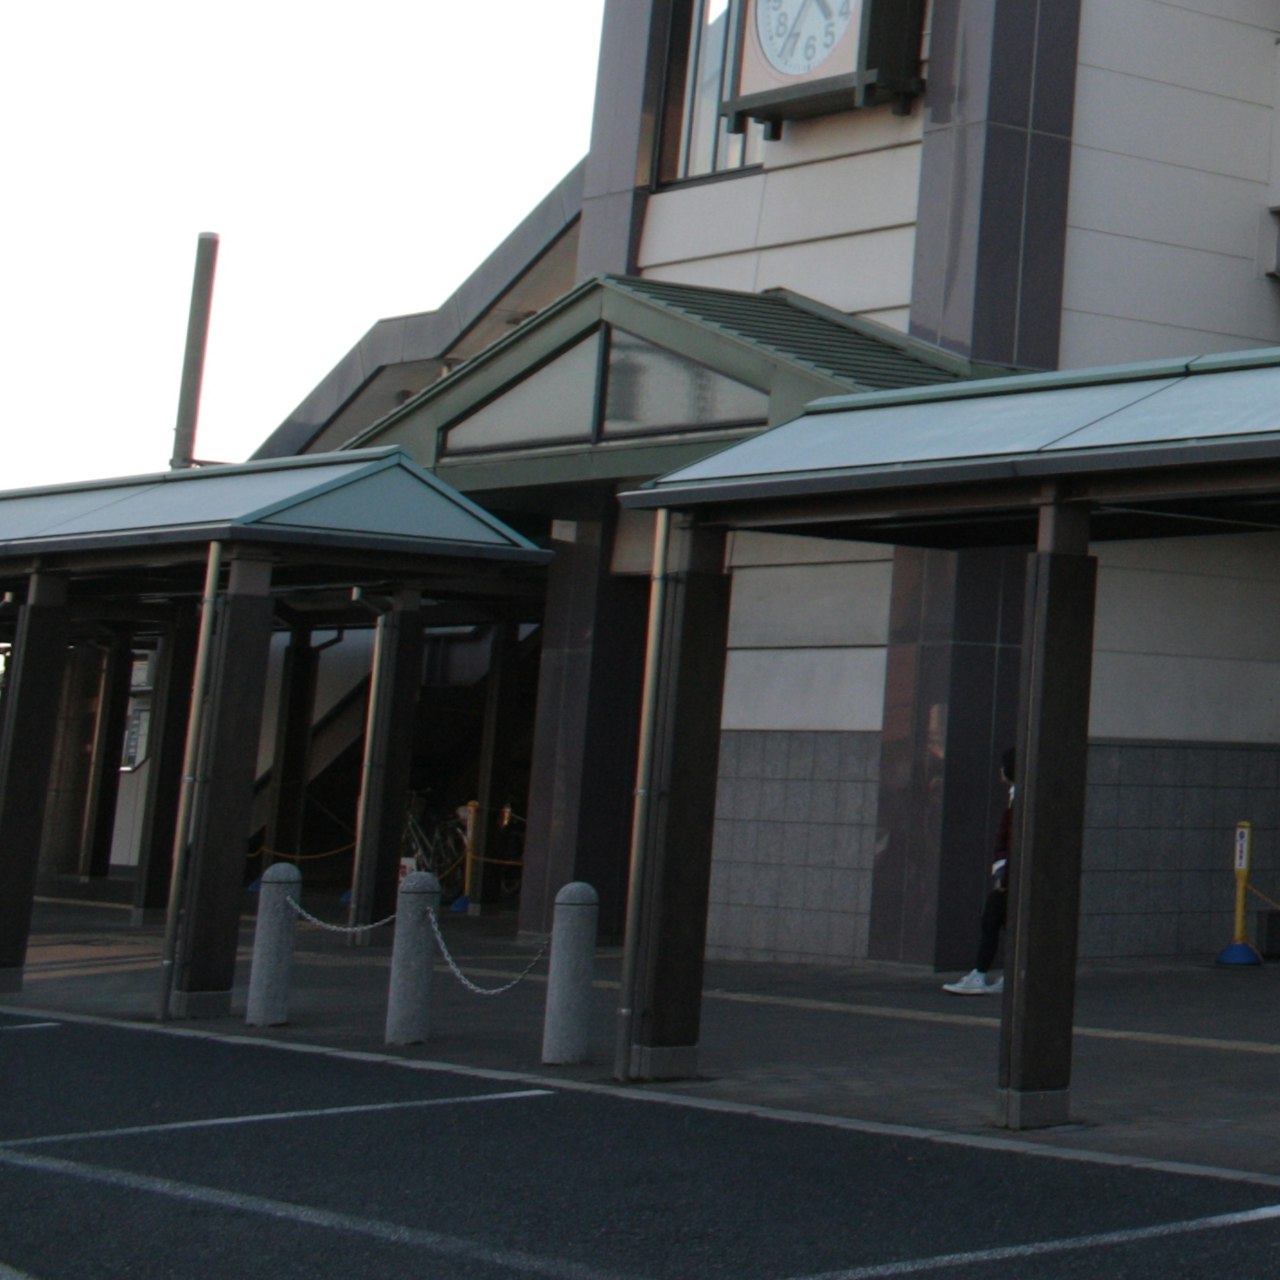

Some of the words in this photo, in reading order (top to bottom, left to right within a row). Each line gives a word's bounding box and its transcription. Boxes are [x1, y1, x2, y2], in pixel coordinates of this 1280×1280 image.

[775, 11, 789, 38] 8
[823, 22, 836, 48] 5
[788, 32, 802, 58] 7
[803, 35, 817, 61] 6
